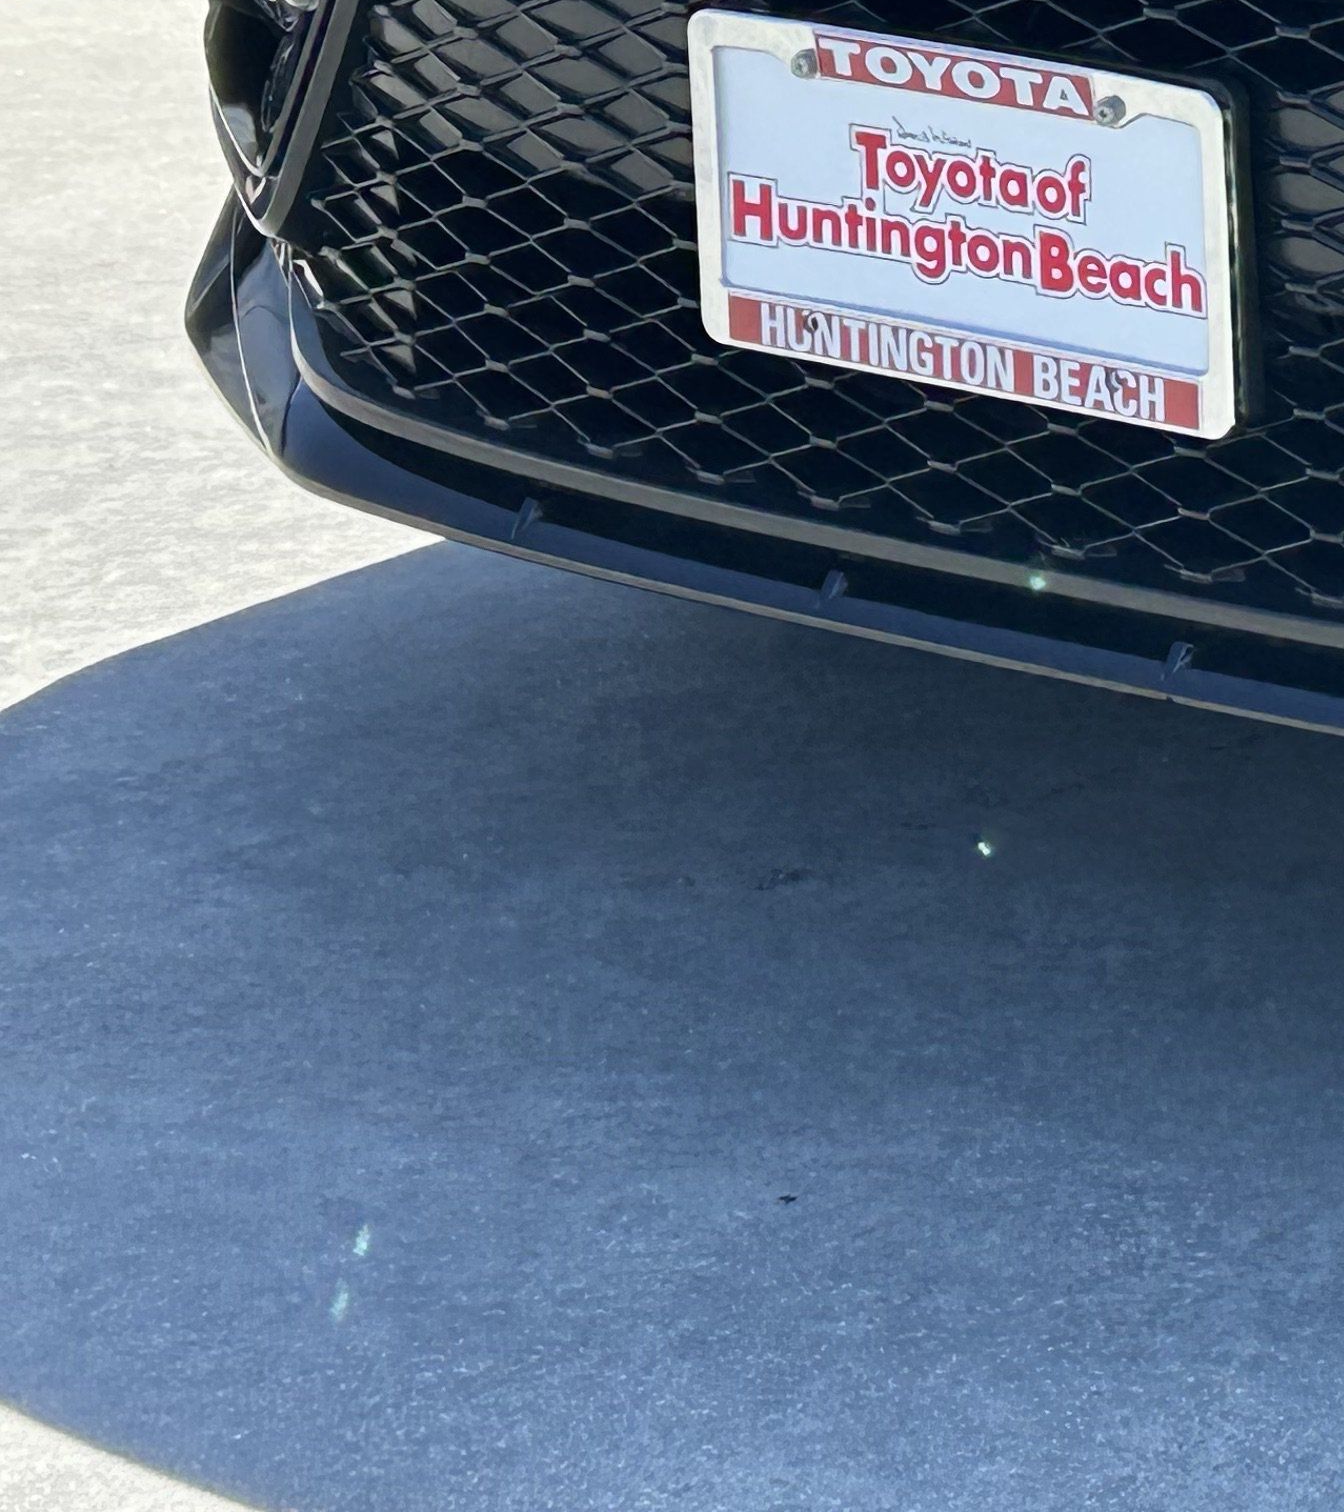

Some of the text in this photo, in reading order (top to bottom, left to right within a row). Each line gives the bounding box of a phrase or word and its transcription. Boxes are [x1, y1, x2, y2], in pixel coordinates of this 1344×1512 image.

[816, 37, 1090, 117] TOYOTA
[853, 129, 1031, 208] Toyota
[1034, 158, 1090, 219] of
[730, 178, 1205, 314] Huntington Beach
[760, 301, 1166, 423] HUNTINGTON BEACH
